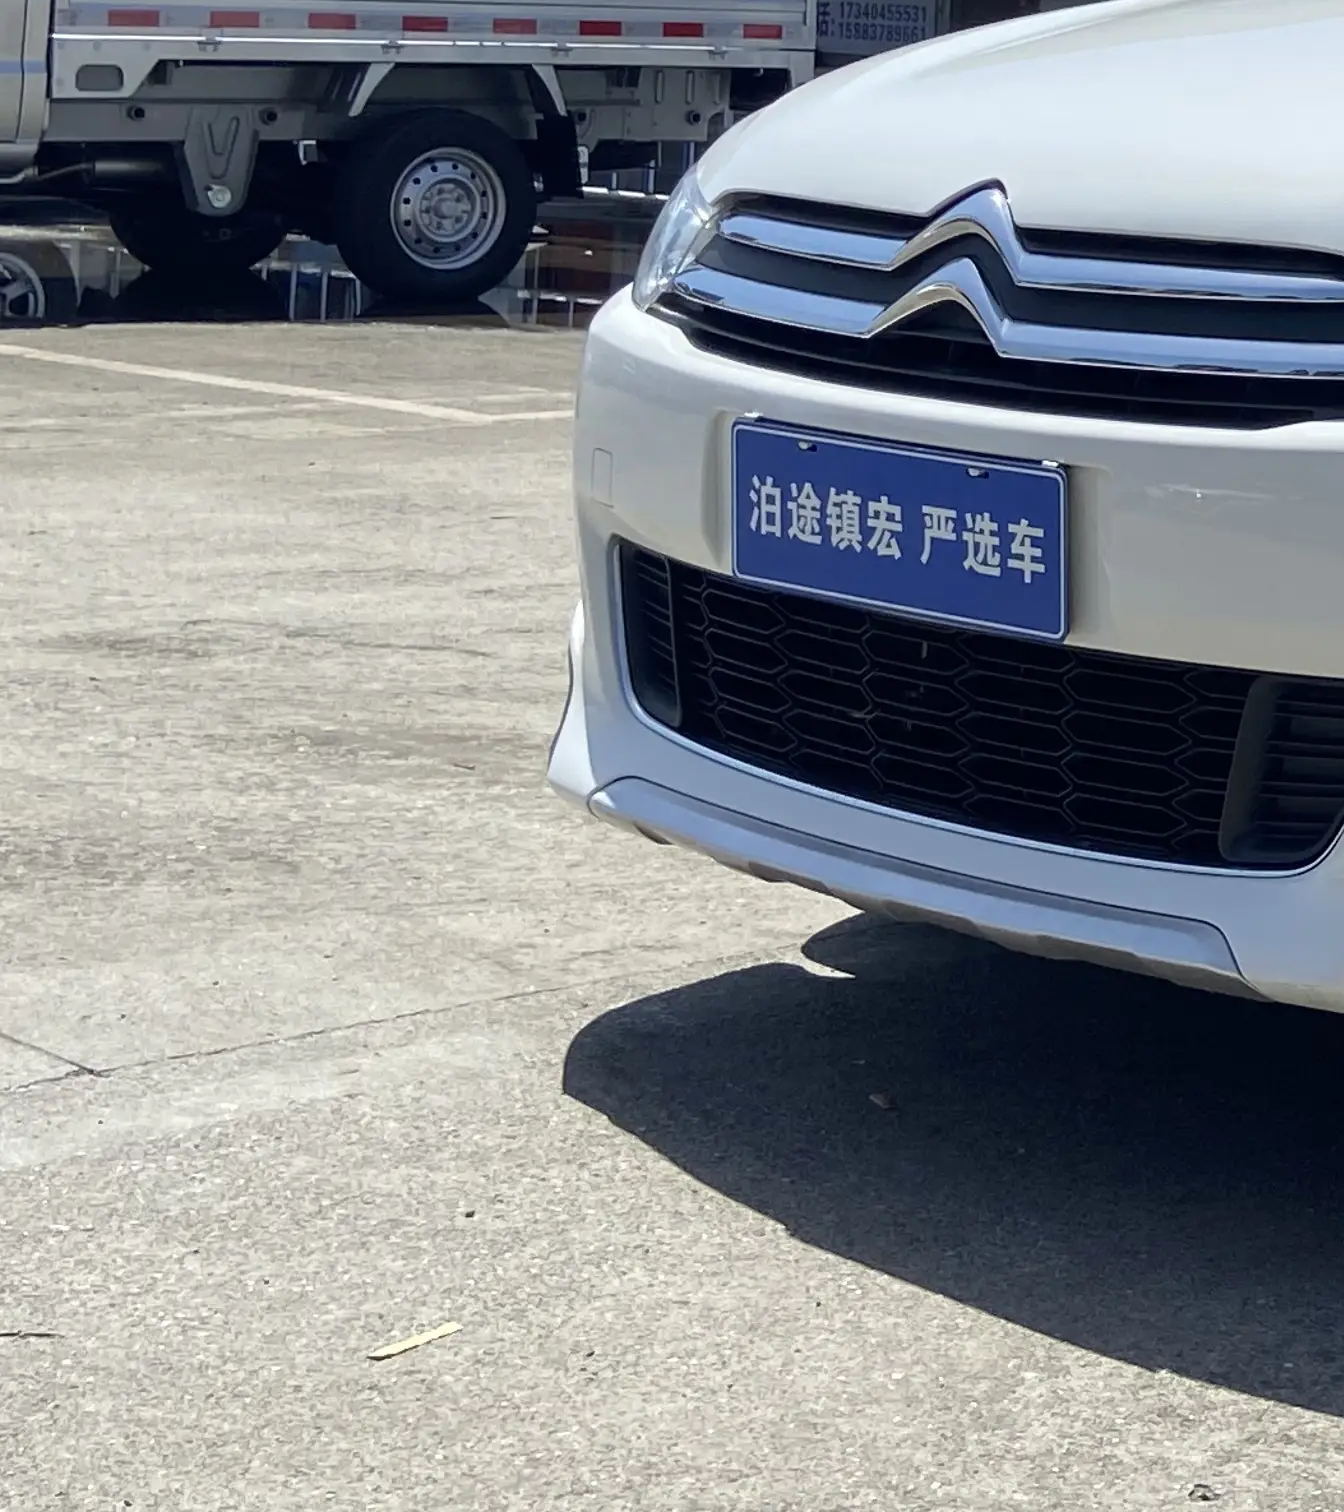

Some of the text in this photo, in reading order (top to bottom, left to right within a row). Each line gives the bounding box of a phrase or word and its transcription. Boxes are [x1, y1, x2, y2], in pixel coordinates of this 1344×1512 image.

[749, 474, 1046, 584] 泊途镇宏 严选车
